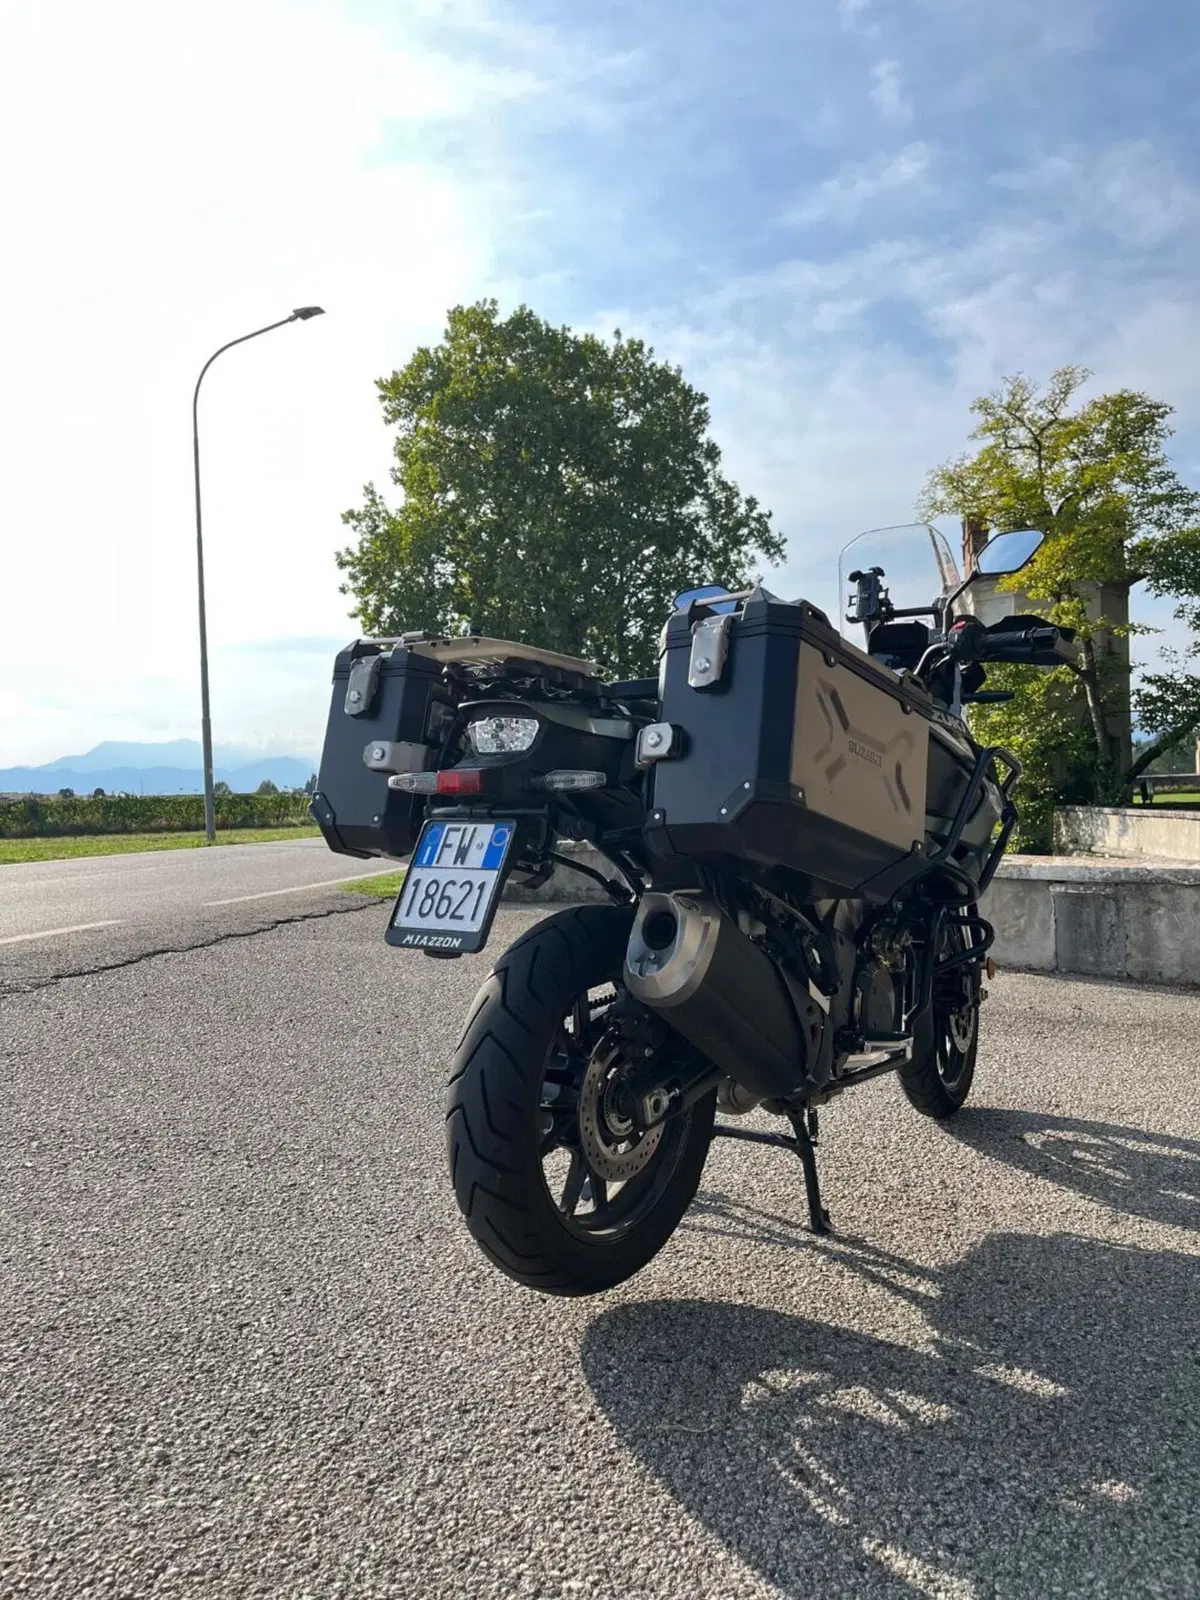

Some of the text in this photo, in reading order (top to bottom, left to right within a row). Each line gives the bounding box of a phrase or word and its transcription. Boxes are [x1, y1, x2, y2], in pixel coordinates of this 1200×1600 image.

[436, 827, 478, 865] FW
[405, 878, 487, 921] 18621
[402, 934, 462, 947] MIAZZON
